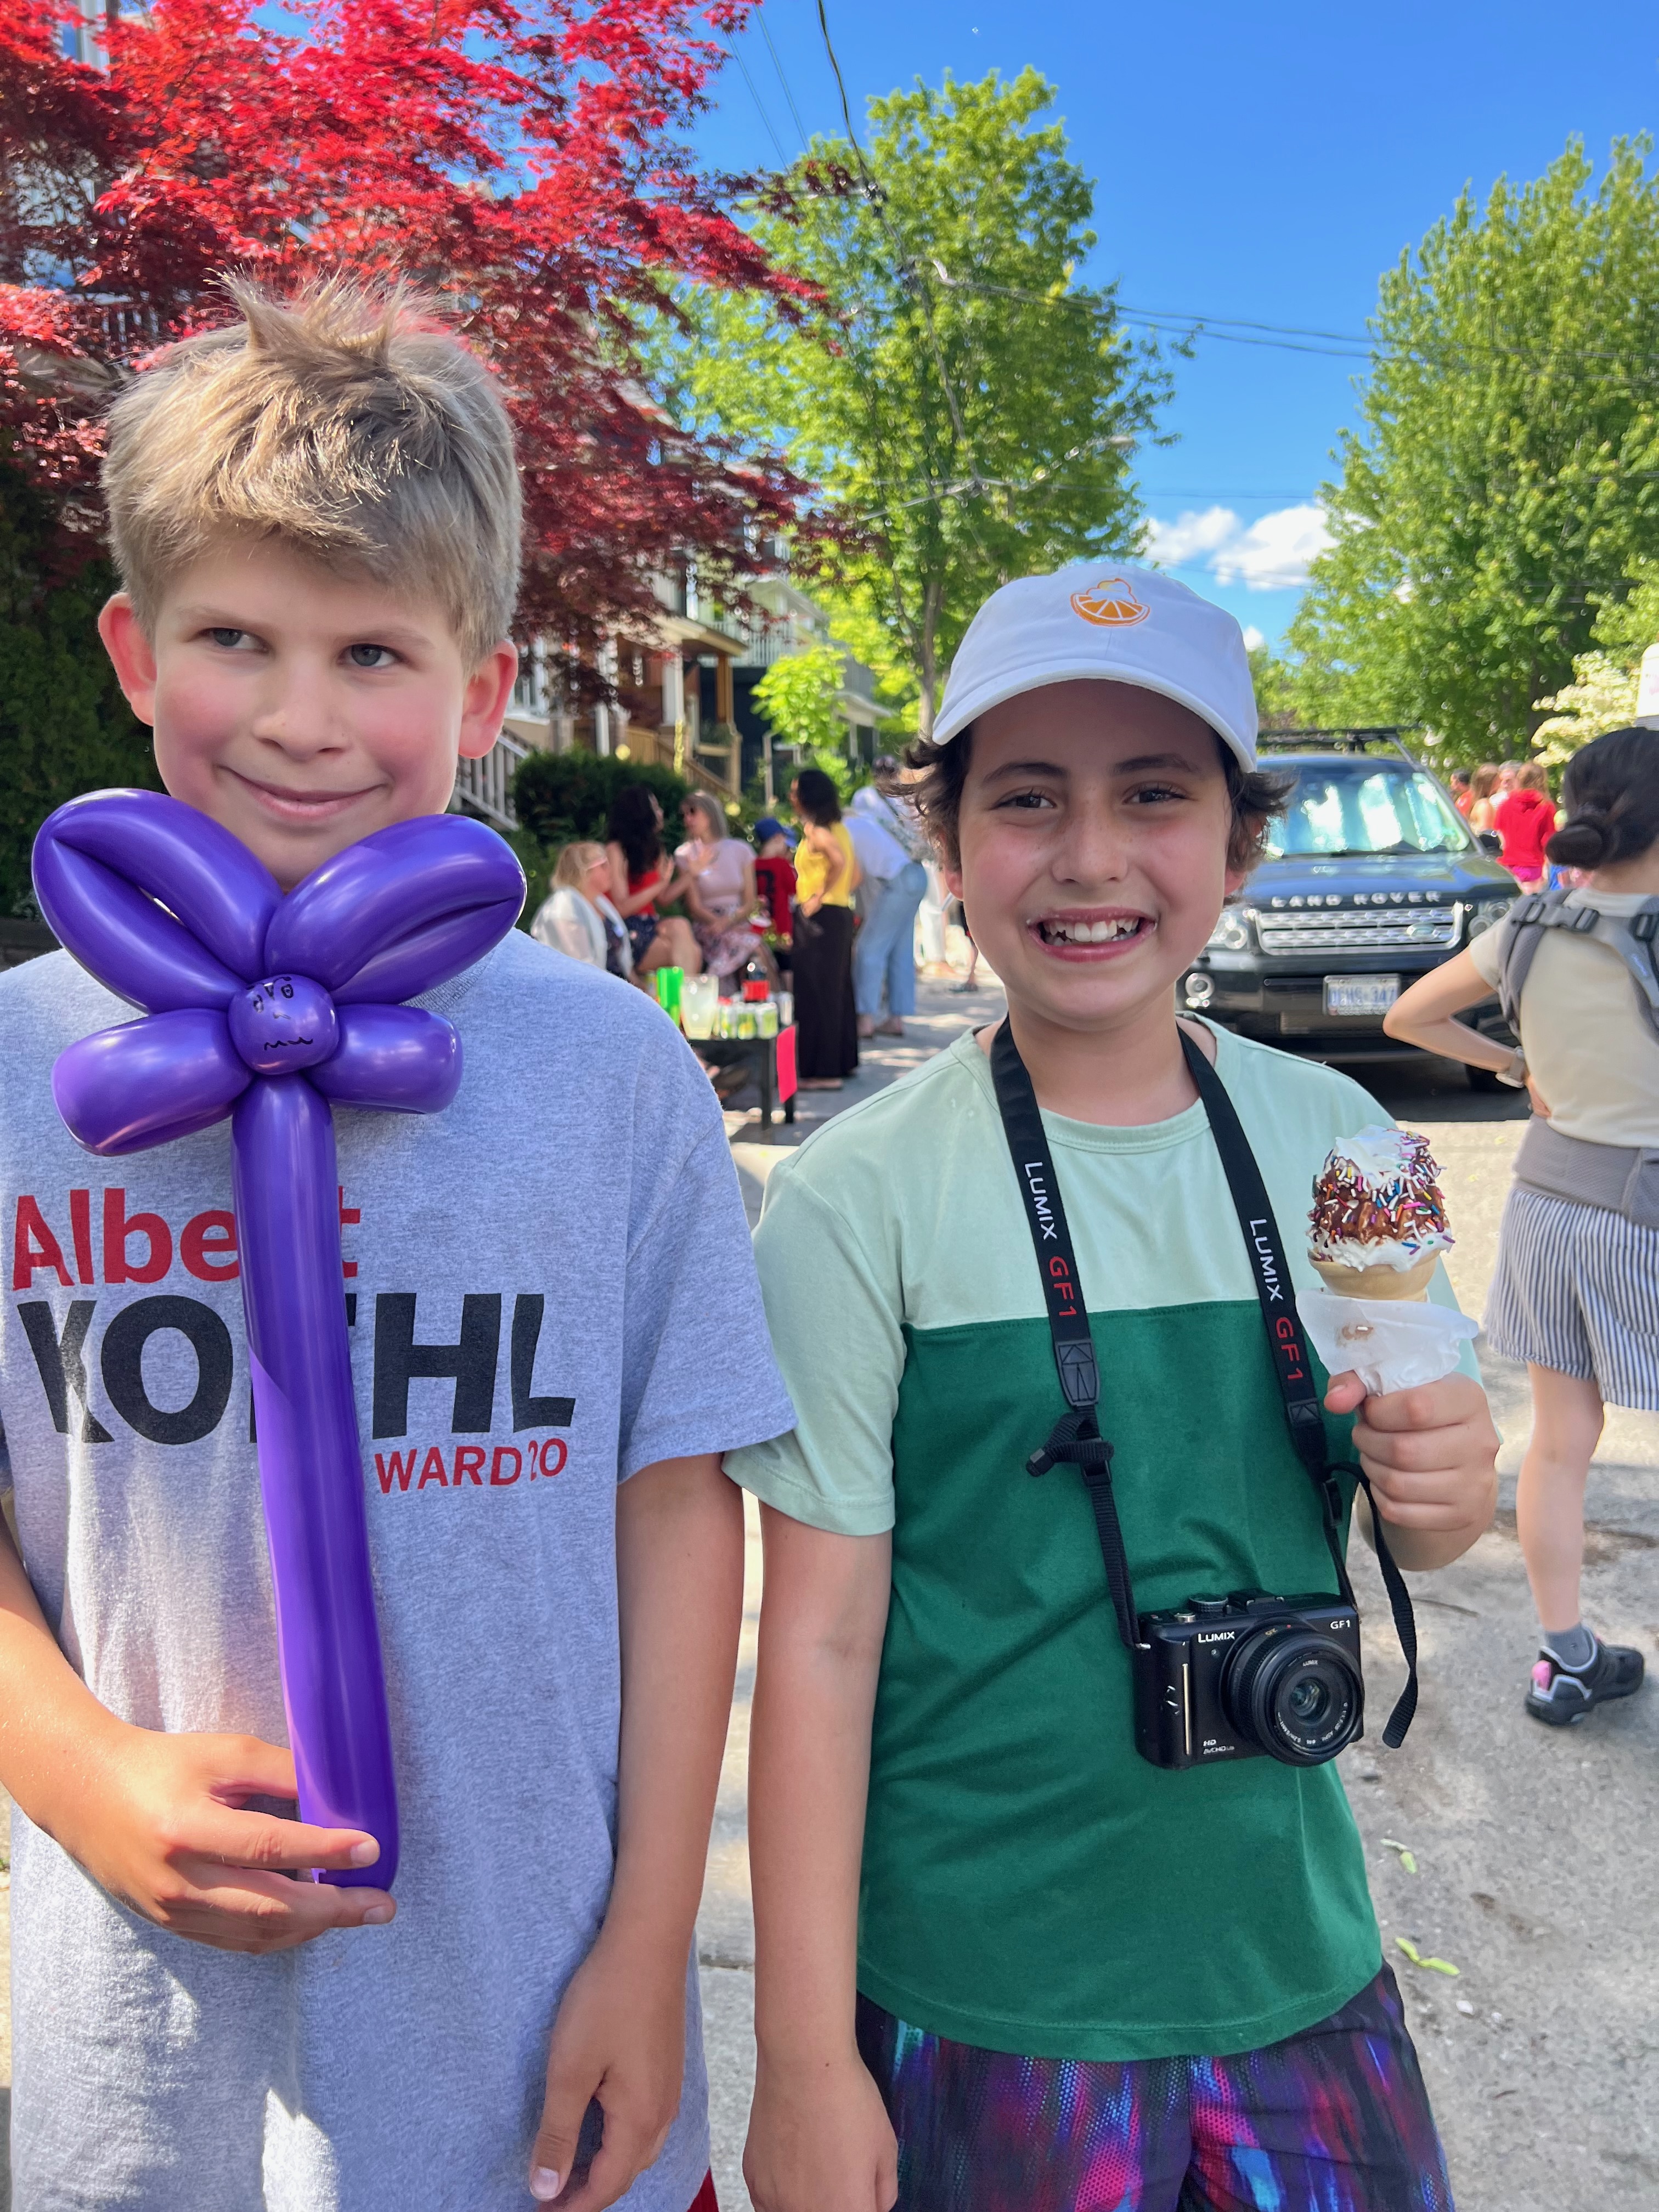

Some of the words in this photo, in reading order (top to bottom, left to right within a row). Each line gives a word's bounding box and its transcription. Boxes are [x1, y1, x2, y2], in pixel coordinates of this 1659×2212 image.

[1271, 894, 1344, 908] LAND
[1353, 890, 1442, 905] ROVER
[13, 1187, 361, 1291] Albet
[1024, 1161, 1058, 1241] LUMIX
[1049, 1256, 1077, 1316] GF1
[1249, 1218, 1284, 1301] LUMIX
[1276, 1317, 1303, 1380] GF1
[17, 1292, 577, 1445] KOHL
[374, 1446, 522, 1494] WARD
[1198, 1631, 1235, 1643] LUMIX
[1330, 1620, 1351, 1629] GF1
